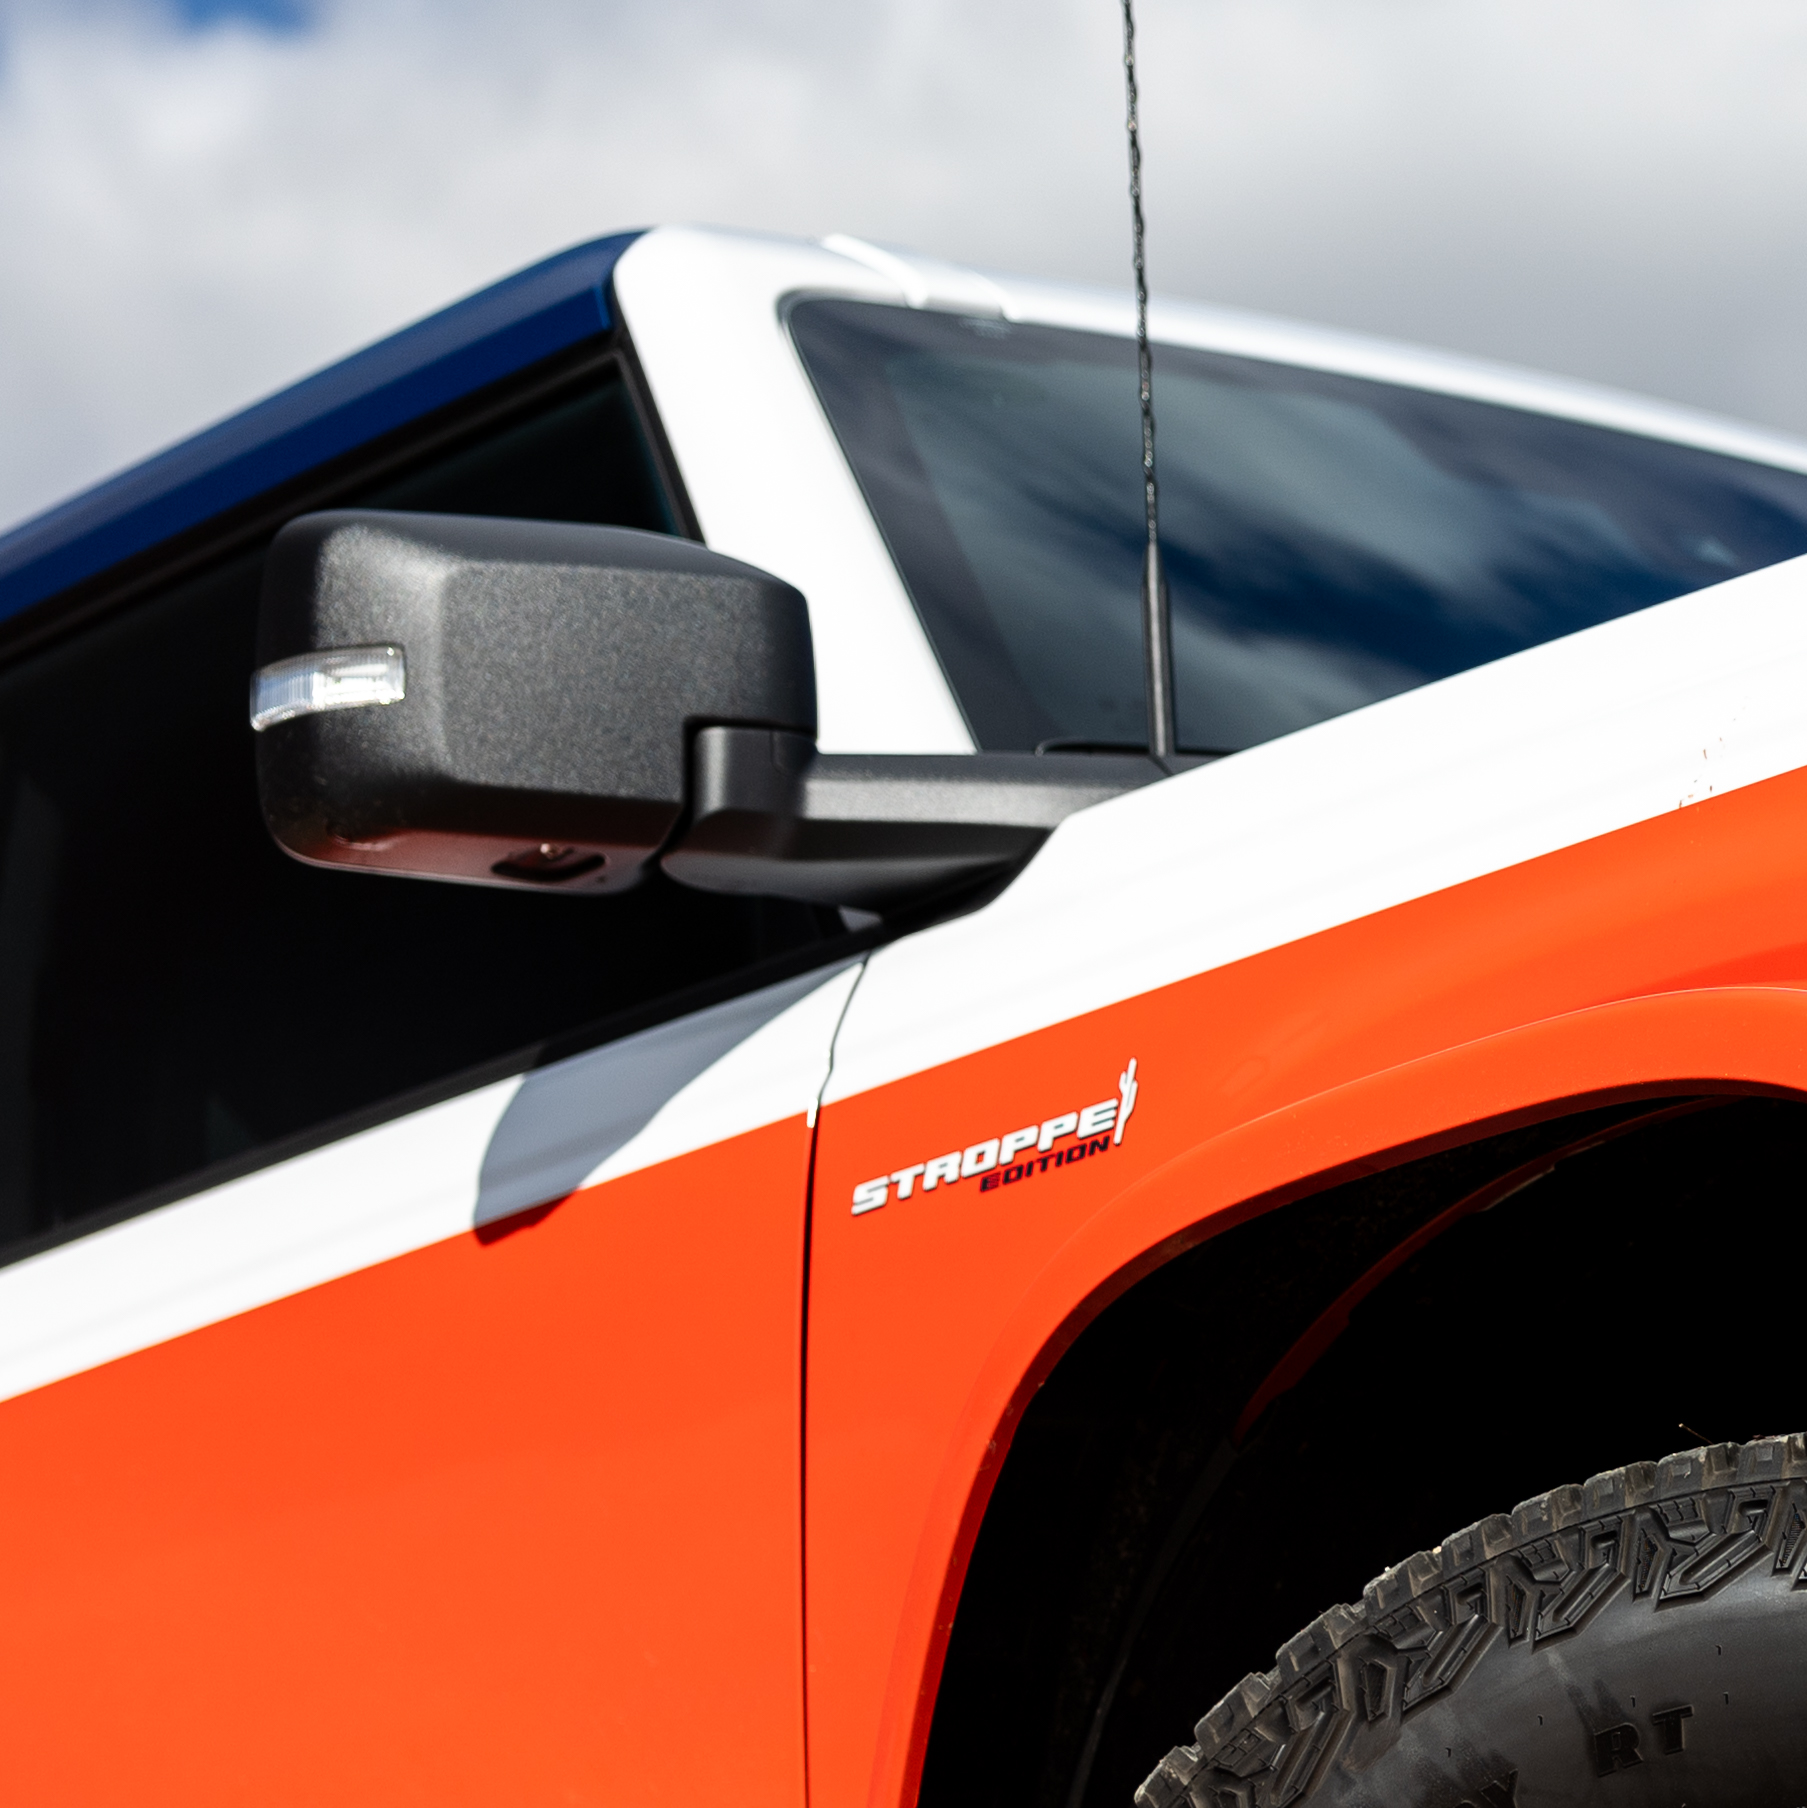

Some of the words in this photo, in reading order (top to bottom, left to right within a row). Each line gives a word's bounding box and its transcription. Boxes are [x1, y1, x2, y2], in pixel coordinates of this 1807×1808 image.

[851, 1098, 1119, 1216] STROPPE
[979, 1135, 1111, 1193] EDITION
[1591, 1705, 1693, 1777] RT
